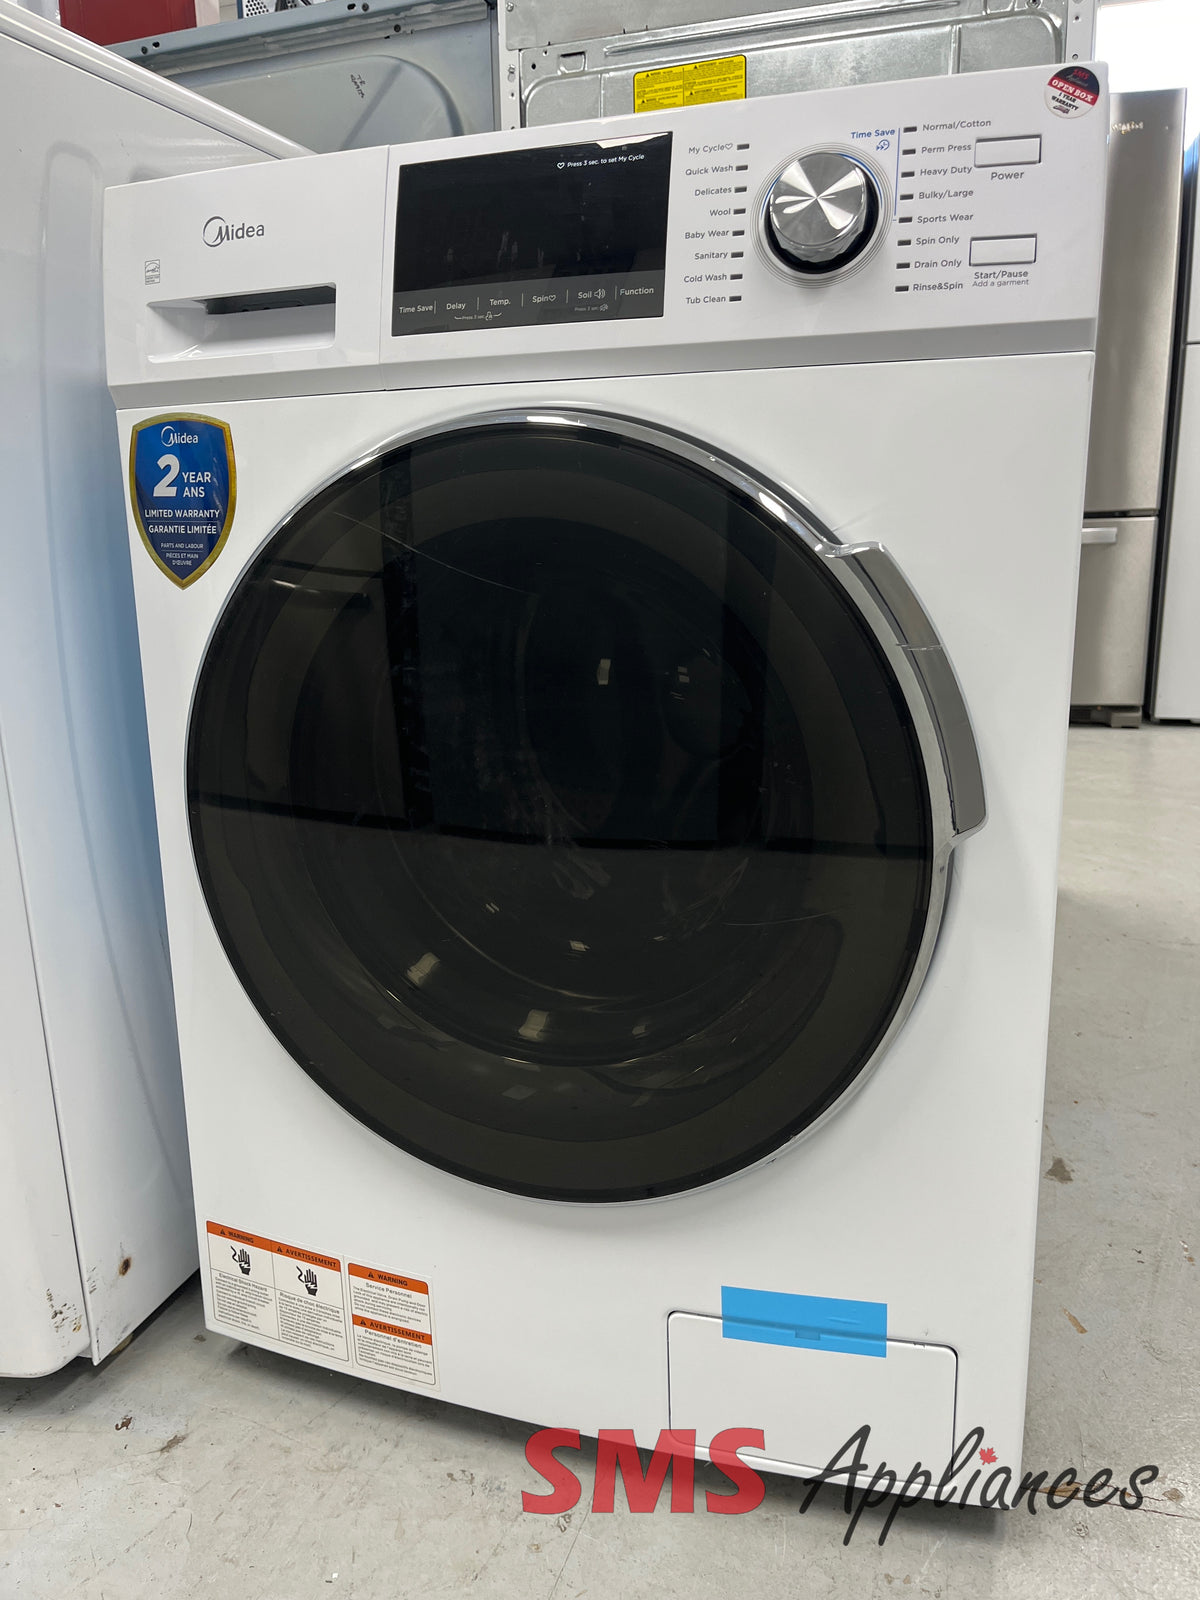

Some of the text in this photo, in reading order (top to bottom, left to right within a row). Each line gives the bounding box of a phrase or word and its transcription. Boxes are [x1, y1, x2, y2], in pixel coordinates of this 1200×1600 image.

[1052, 80, 1075, 94] OPEN
[1074, 89, 1094, 102] BOX
[1052, 96, 1079, 110] WARRANTY
[1063, 94, 1076, 103] YEAR
[922, 119, 992, 132] Normal/Cotton
[850, 128, 895, 139] Time Save
[702, 144, 725, 152] Cycle
[921, 143, 972, 154] Perm Press
[685, 167, 708, 176] Quick
[920, 166, 972, 176] Heavy Duty
[990, 171, 1024, 180] Power
[695, 186, 732, 196] Delicates
[918, 189, 974, 200] Bulky/Large
[710, 208, 731, 216] Wool
[917, 215, 947, 224] Sports
[202, 216, 264, 247] Midea
[916, 236, 959, 246] Spin Only
[695, 251, 728, 260] Sanitary
[914, 259, 962, 269] Drain Only
[684, 275, 702, 283] Cold
[974, 270, 1029, 280] Start/Pause
[913, 282, 963, 292] Rinse&Spin
[997, 279, 1029, 288] garment
[578, 291, 592, 299] Soil
[620, 287, 654, 296] Function
[489, 298, 511, 306] Temp.
[532, 295, 549, 303] Spin
[161, 426, 198, 447] Midea
[153, 454, 211, 497] 2 YEAR
[183, 486, 205, 498] ANS
[175, 510, 220, 518] WARRANTY
[149, 524, 217, 534] GARANTIE LIMITÉE
[228, 1231, 254, 1243] WARNING
[286, 1248, 336, 1267] AVERTISSEMENT
[377, 1274, 408, 1286] WARNING
[370, 1322, 425, 1340] AVERTISSEMENT
